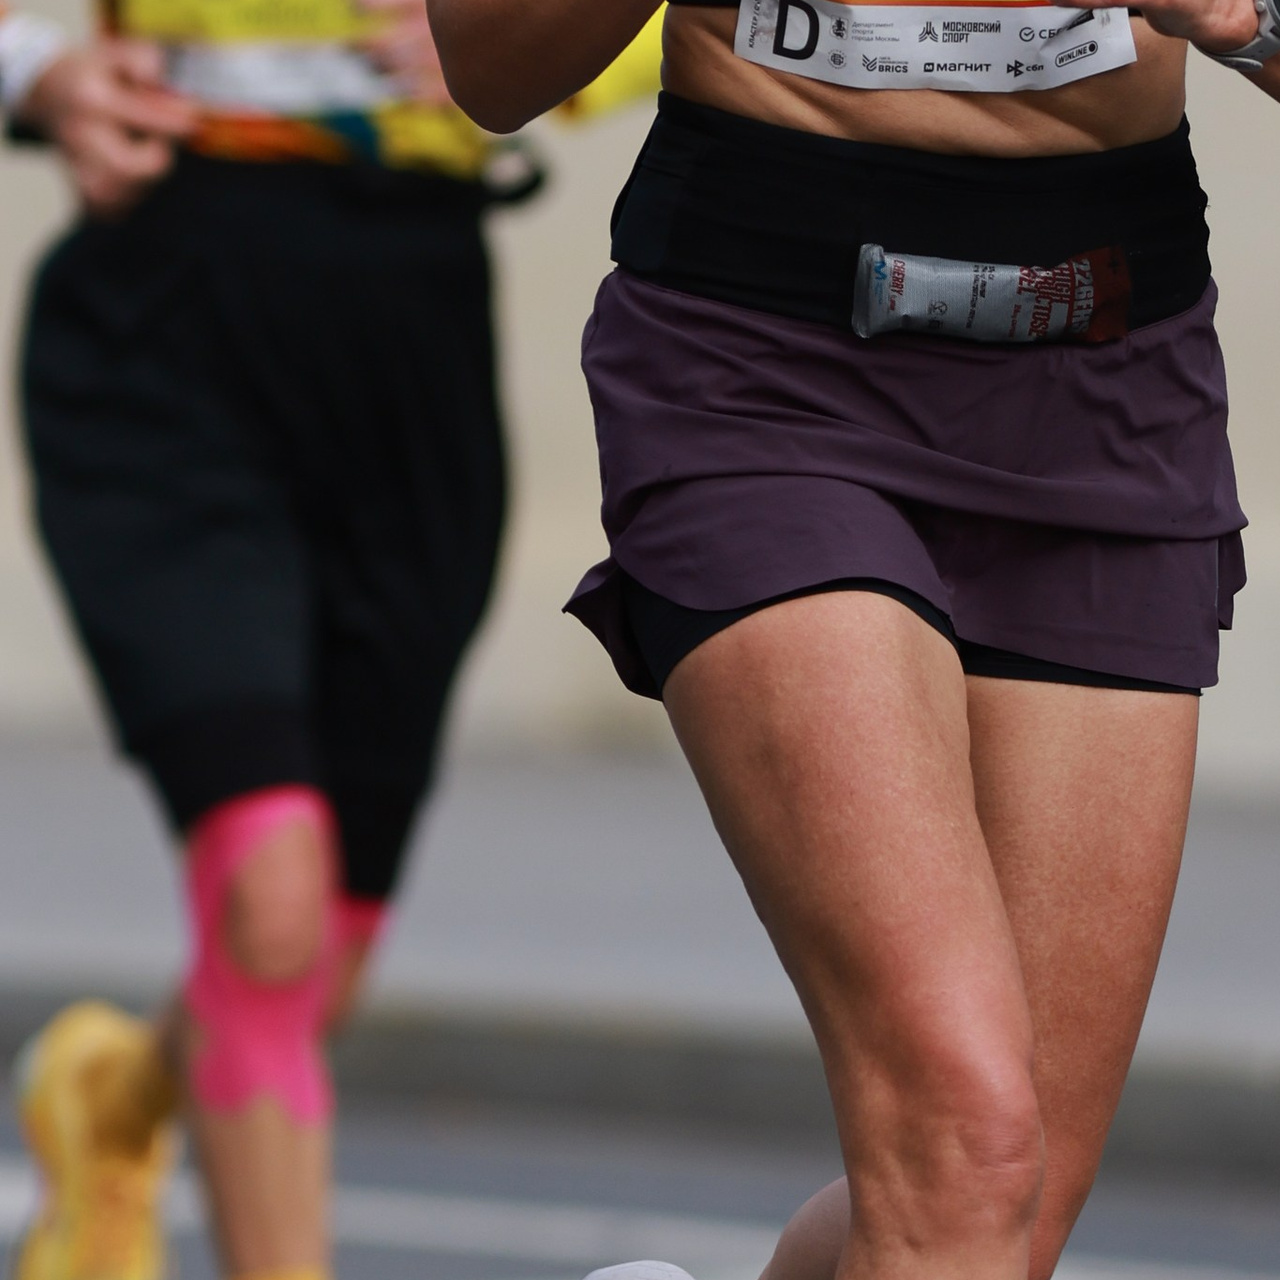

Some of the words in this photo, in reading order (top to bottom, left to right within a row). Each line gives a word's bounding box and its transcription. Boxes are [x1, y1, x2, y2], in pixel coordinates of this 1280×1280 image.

[942, 20, 1001, 33] МОСКОВСКИЙ
[942, 33, 969, 43] СПОРТ
[1058, 46, 1088, 64] WINLINE
[878, 65, 908, 73] BRICS
[1026, 64, 1044, 72] сбп
[1052, 267, 1071, 303] HIGH
[1028, 268, 1053, 336] RUCTOSE
